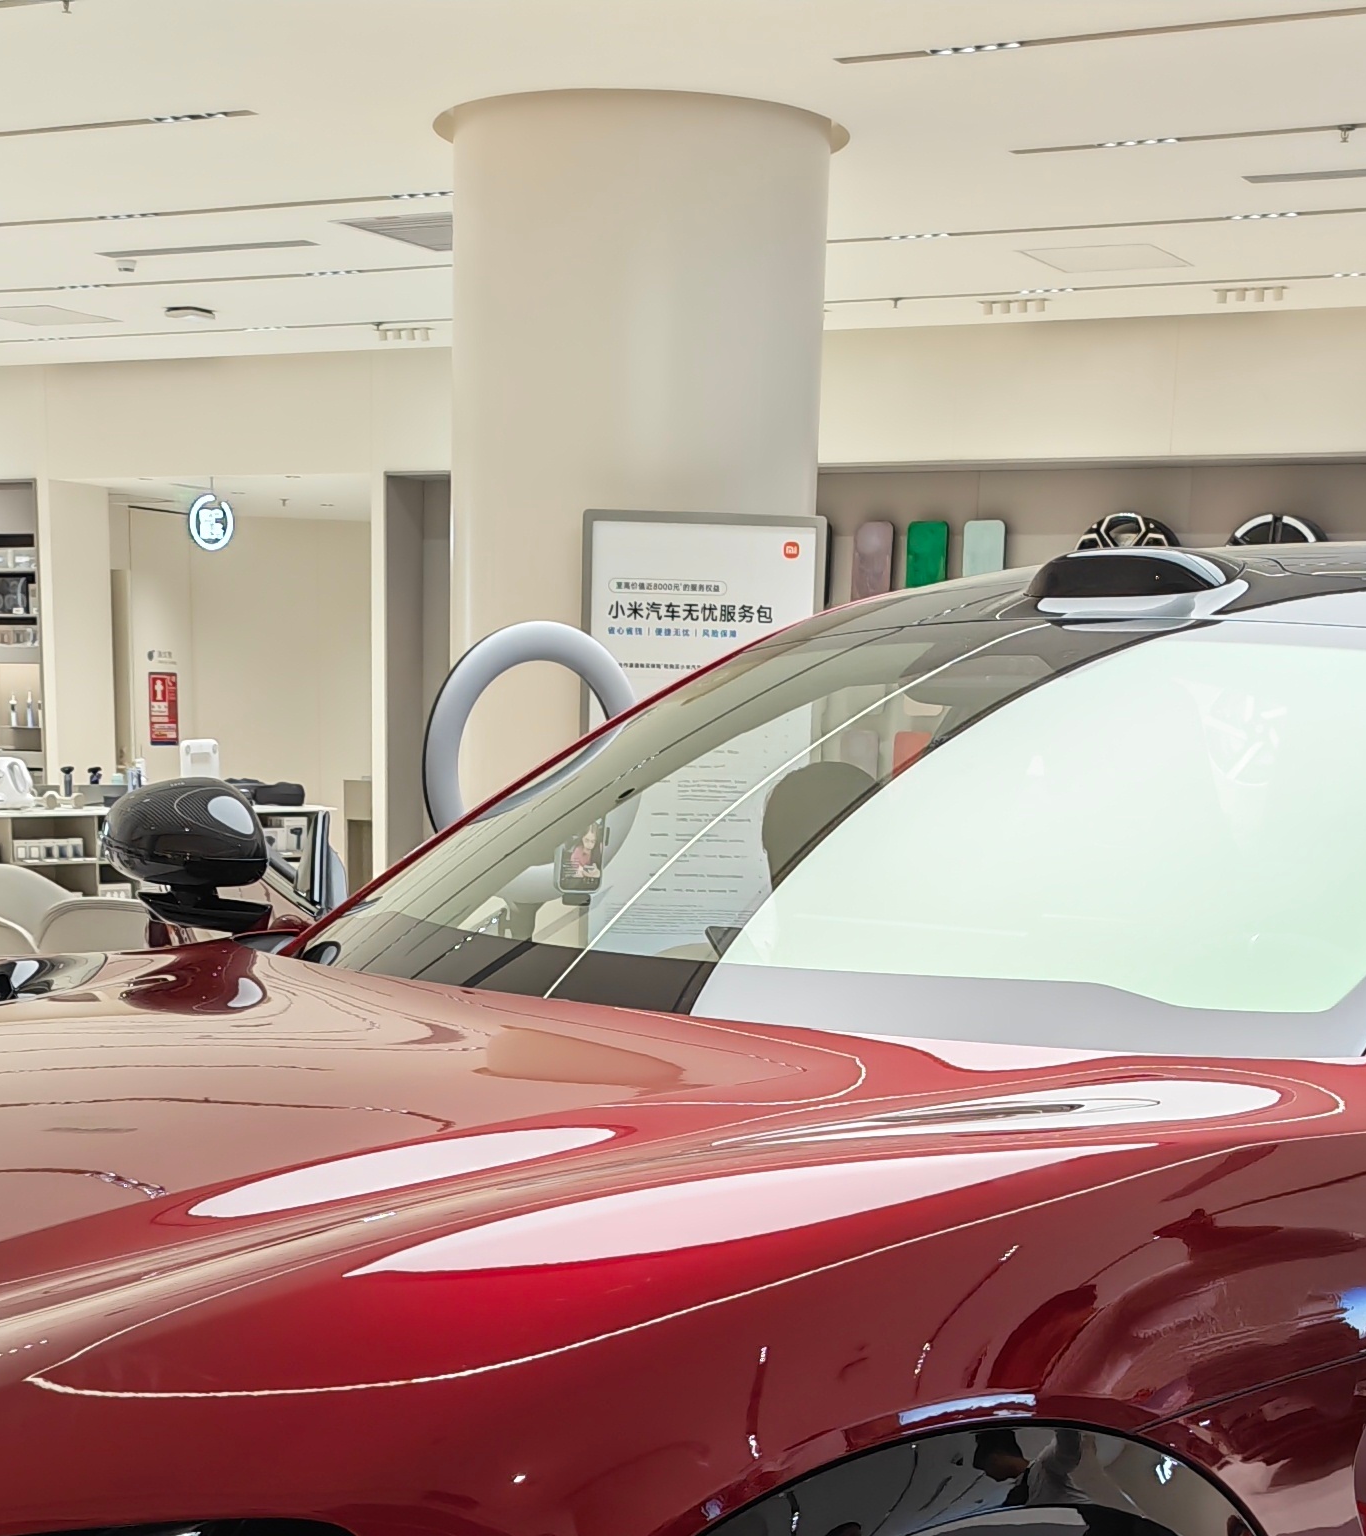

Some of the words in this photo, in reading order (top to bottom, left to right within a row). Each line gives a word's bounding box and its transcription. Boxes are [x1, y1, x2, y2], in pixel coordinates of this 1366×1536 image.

[608, 600, 773, 624] 小米汽车无忧服务包
